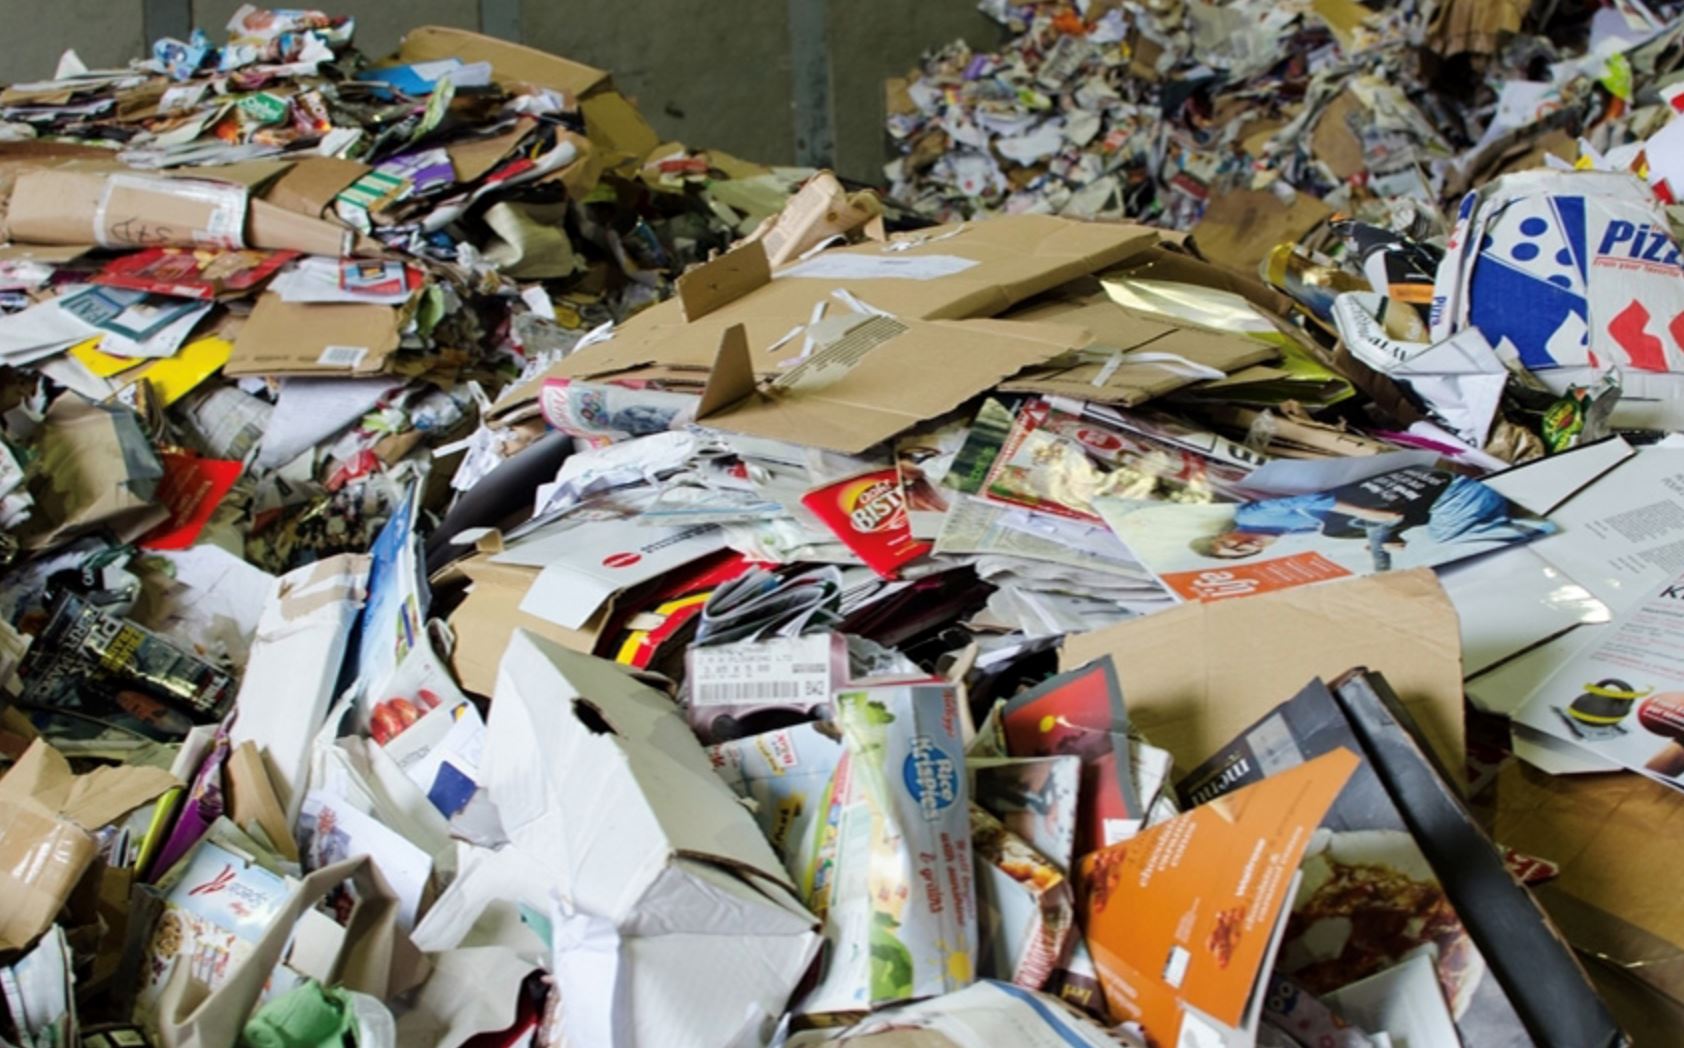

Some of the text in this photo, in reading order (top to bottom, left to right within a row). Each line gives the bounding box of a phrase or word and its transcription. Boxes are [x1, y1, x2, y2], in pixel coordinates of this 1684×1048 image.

[850, 487, 905, 532] BIST
[910, 736, 942, 821] Krispies
[937, 758, 954, 801] Rice
[1191, 757, 1251, 806] menu
[918, 867, 945, 914] grains
